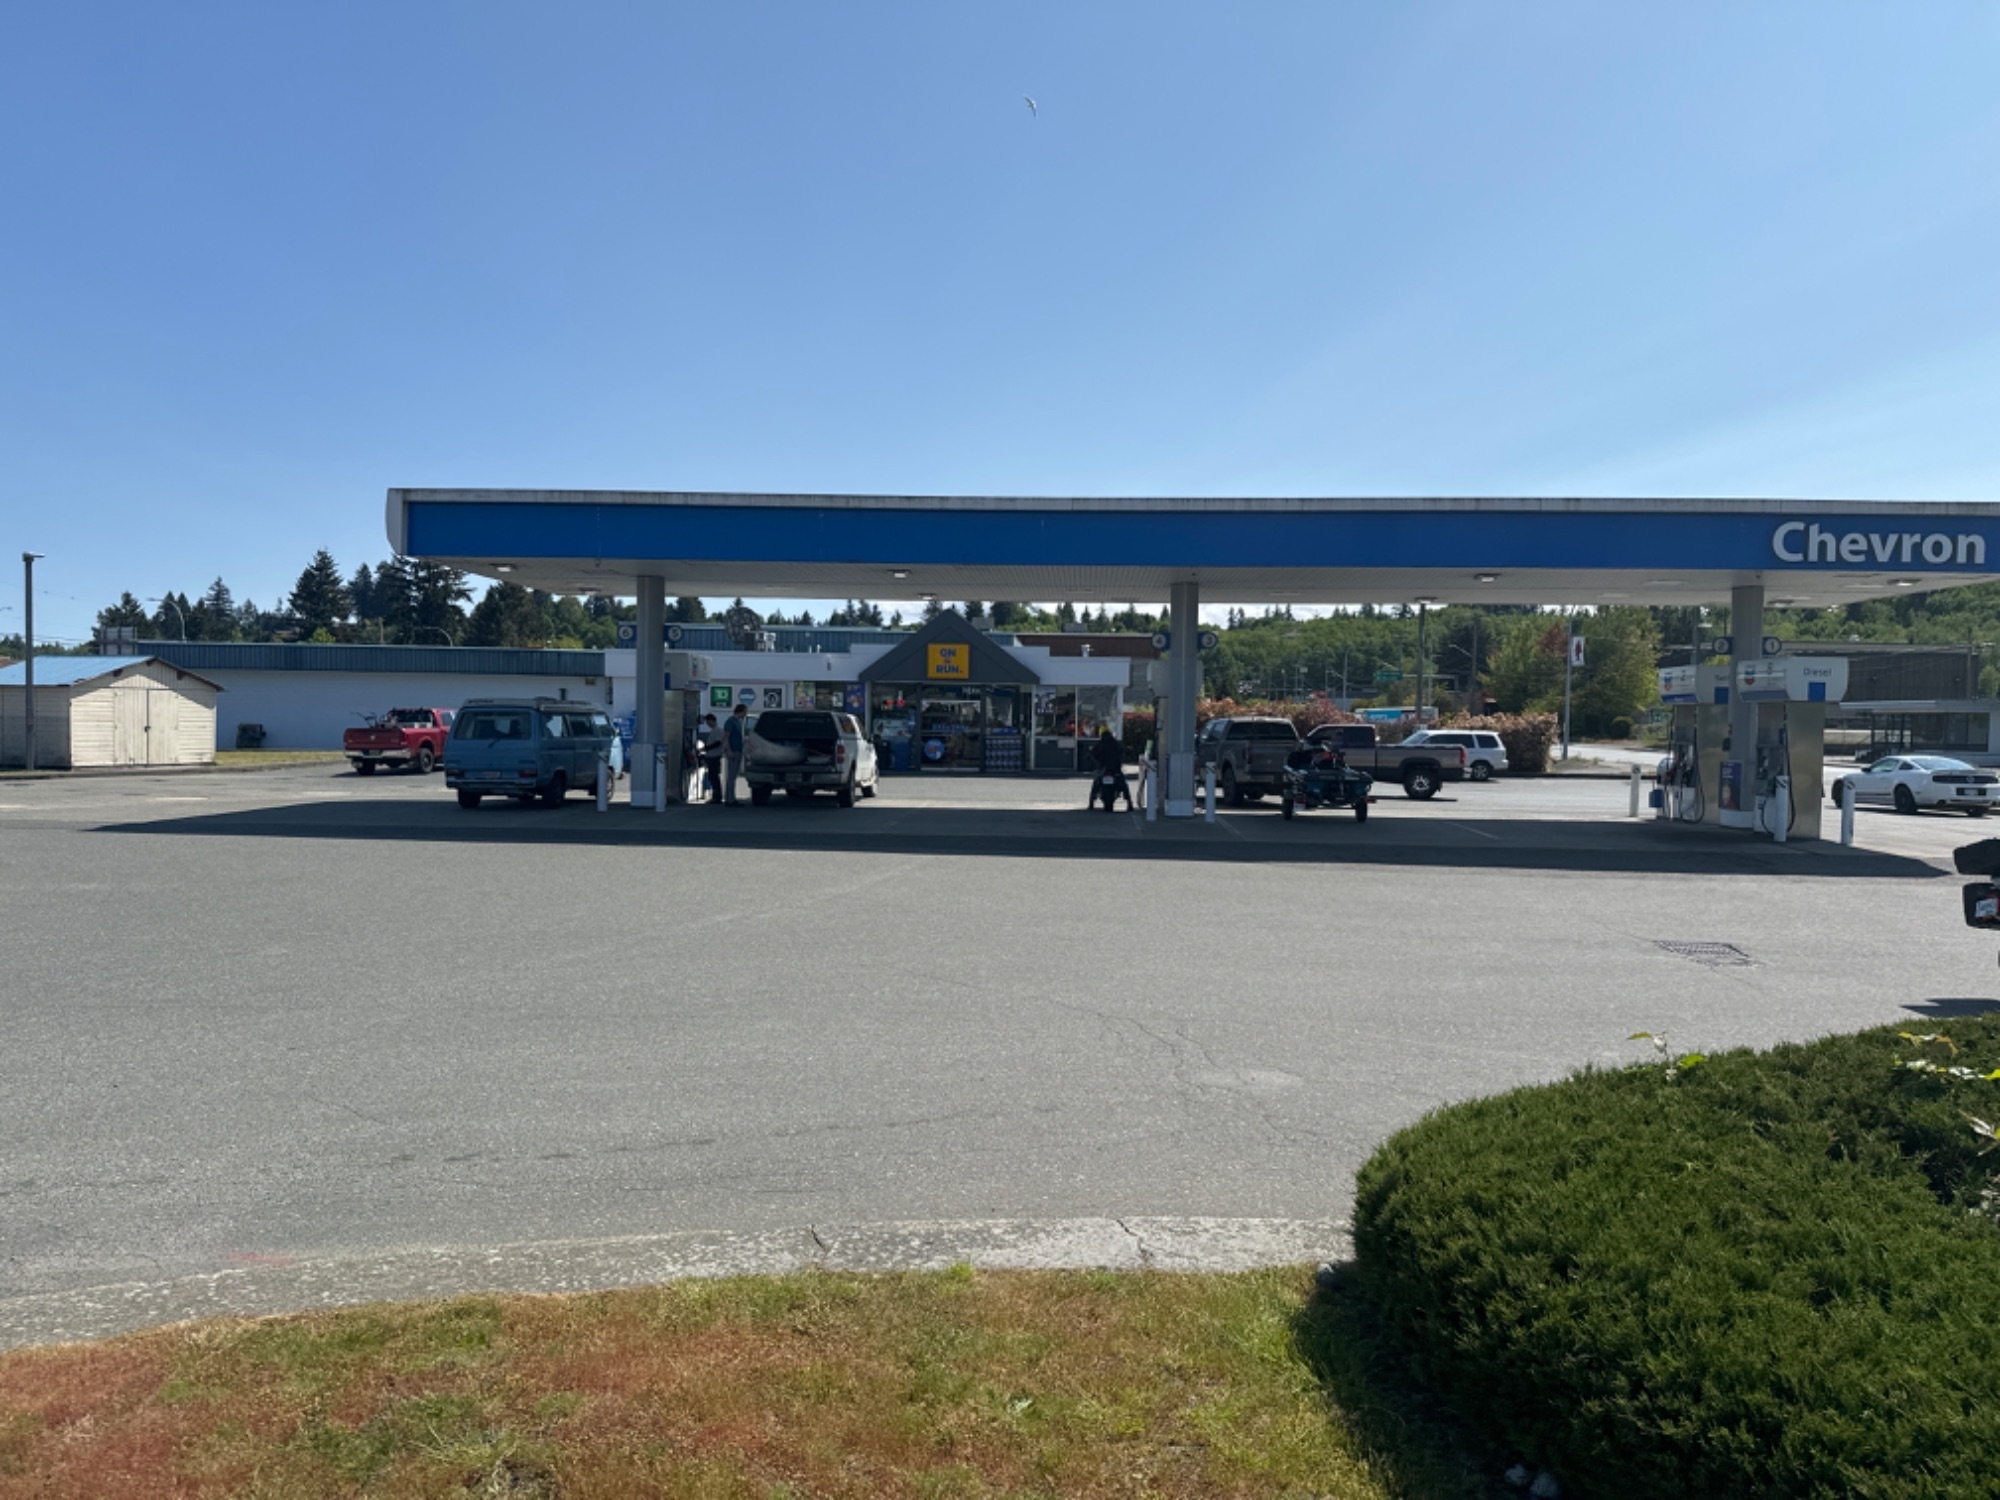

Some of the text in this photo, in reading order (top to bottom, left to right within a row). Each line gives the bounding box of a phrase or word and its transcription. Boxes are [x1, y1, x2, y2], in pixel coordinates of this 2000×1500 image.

[1772, 520, 1986, 565] Chevron
[940, 648, 957, 657] ON
[1803, 667, 1832, 677] Diesel
